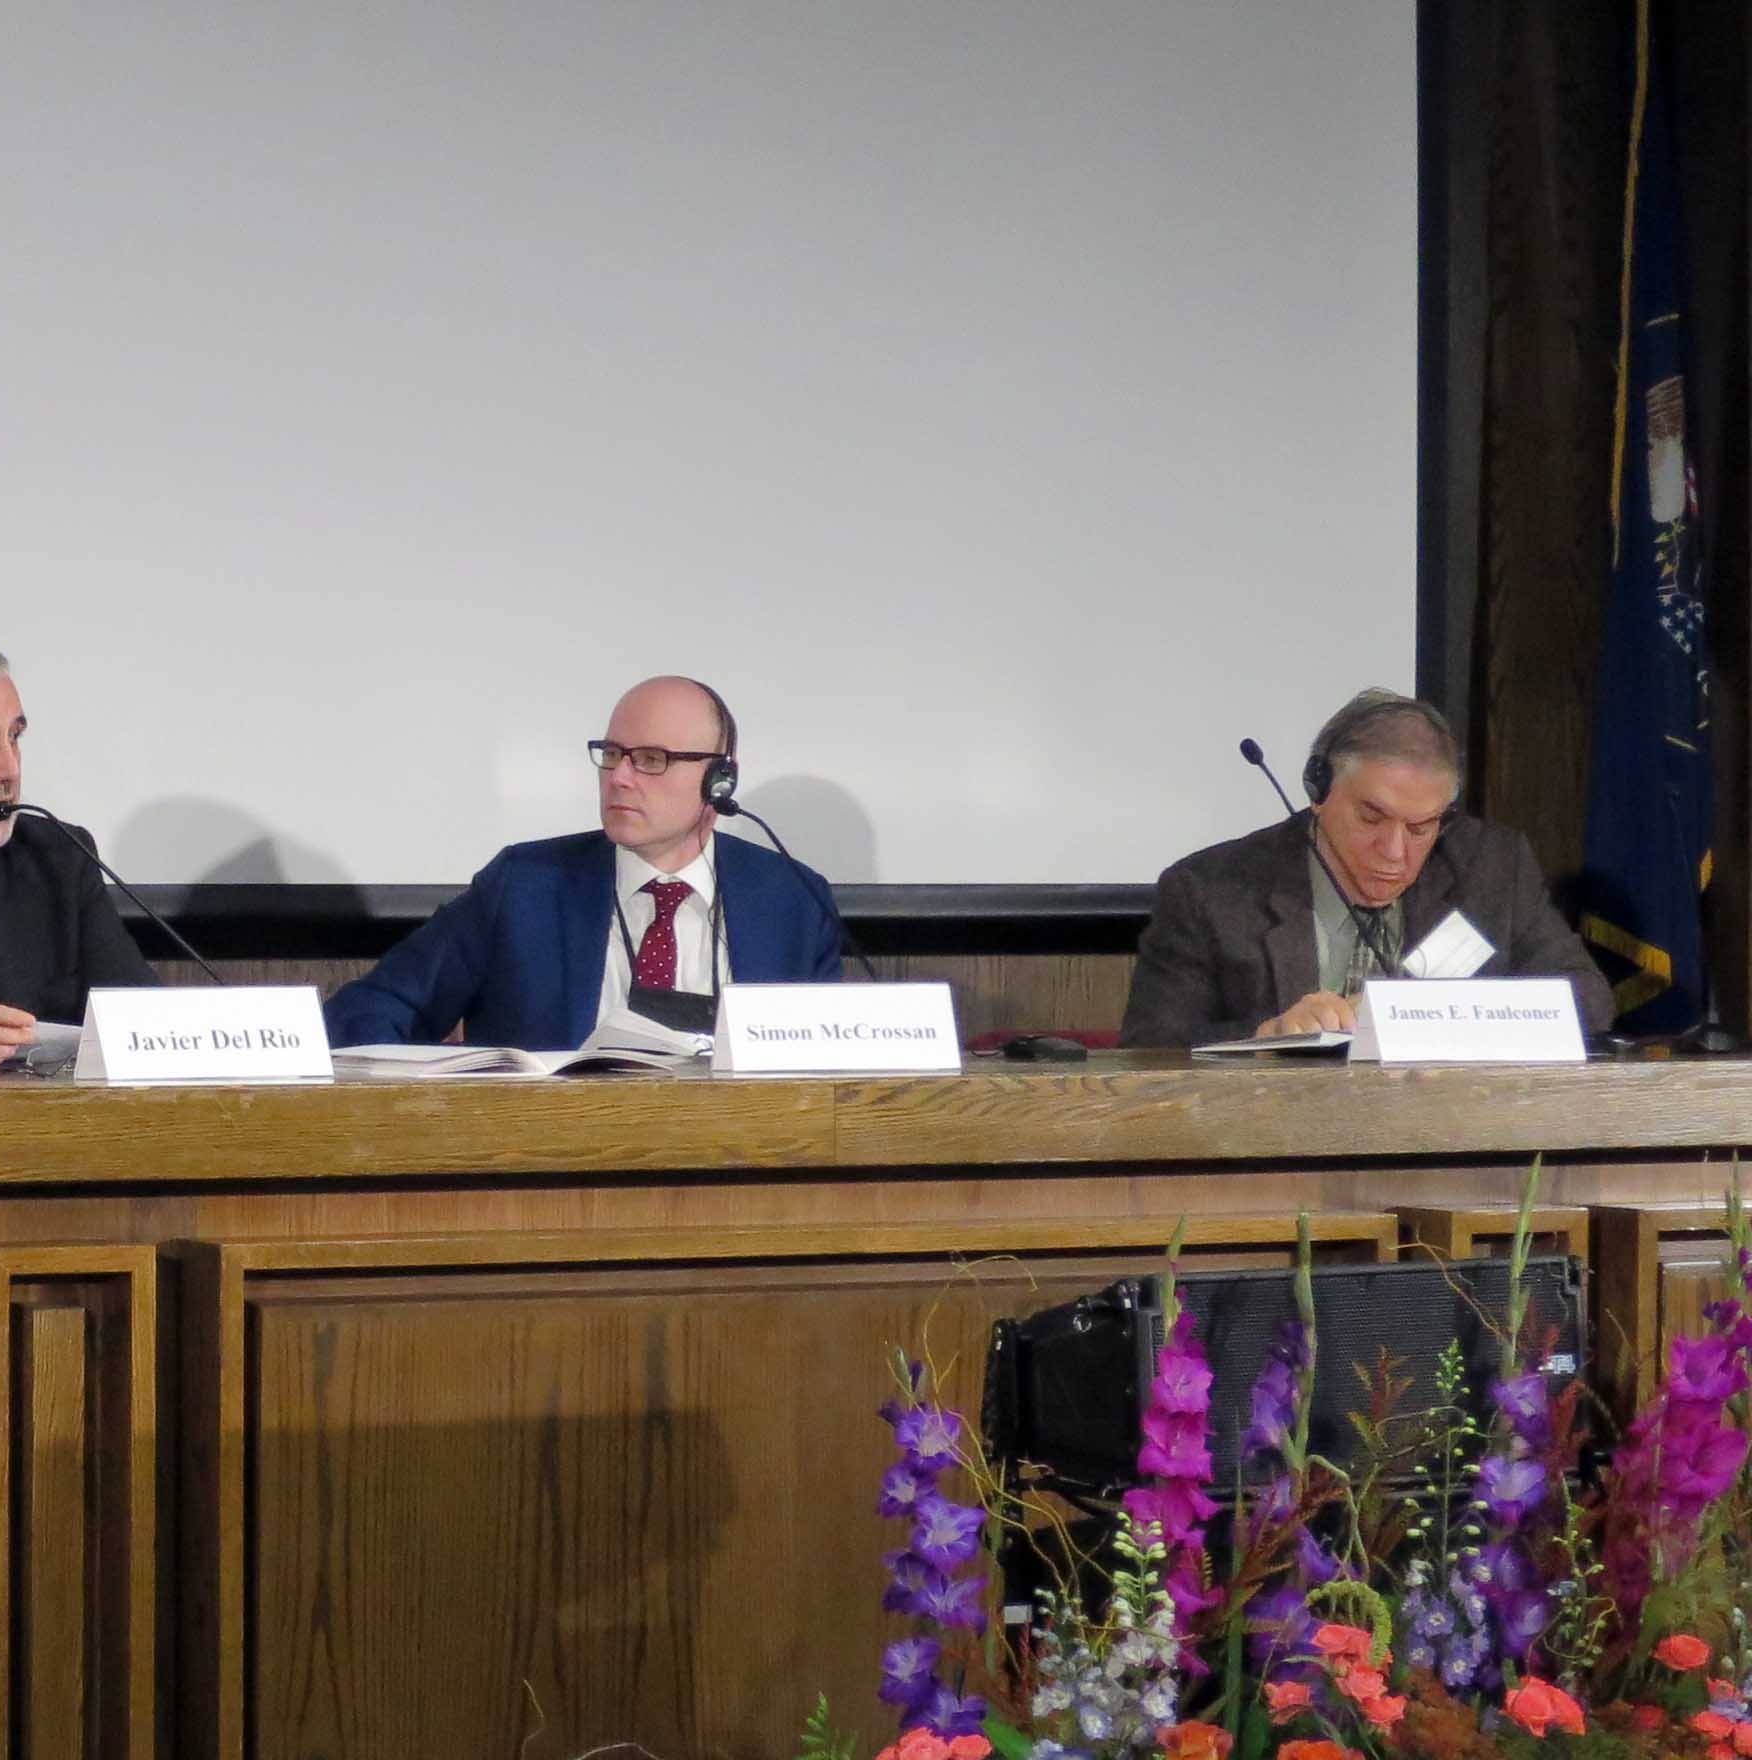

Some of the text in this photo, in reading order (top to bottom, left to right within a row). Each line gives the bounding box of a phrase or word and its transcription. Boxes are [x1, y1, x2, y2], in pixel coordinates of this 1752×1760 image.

[1388, 1004, 1561, 1021] James E. Faulconer
[127, 1028, 301, 1052] Javier Del Rio
[746, 1023, 937, 1042] Simon McCrossan
